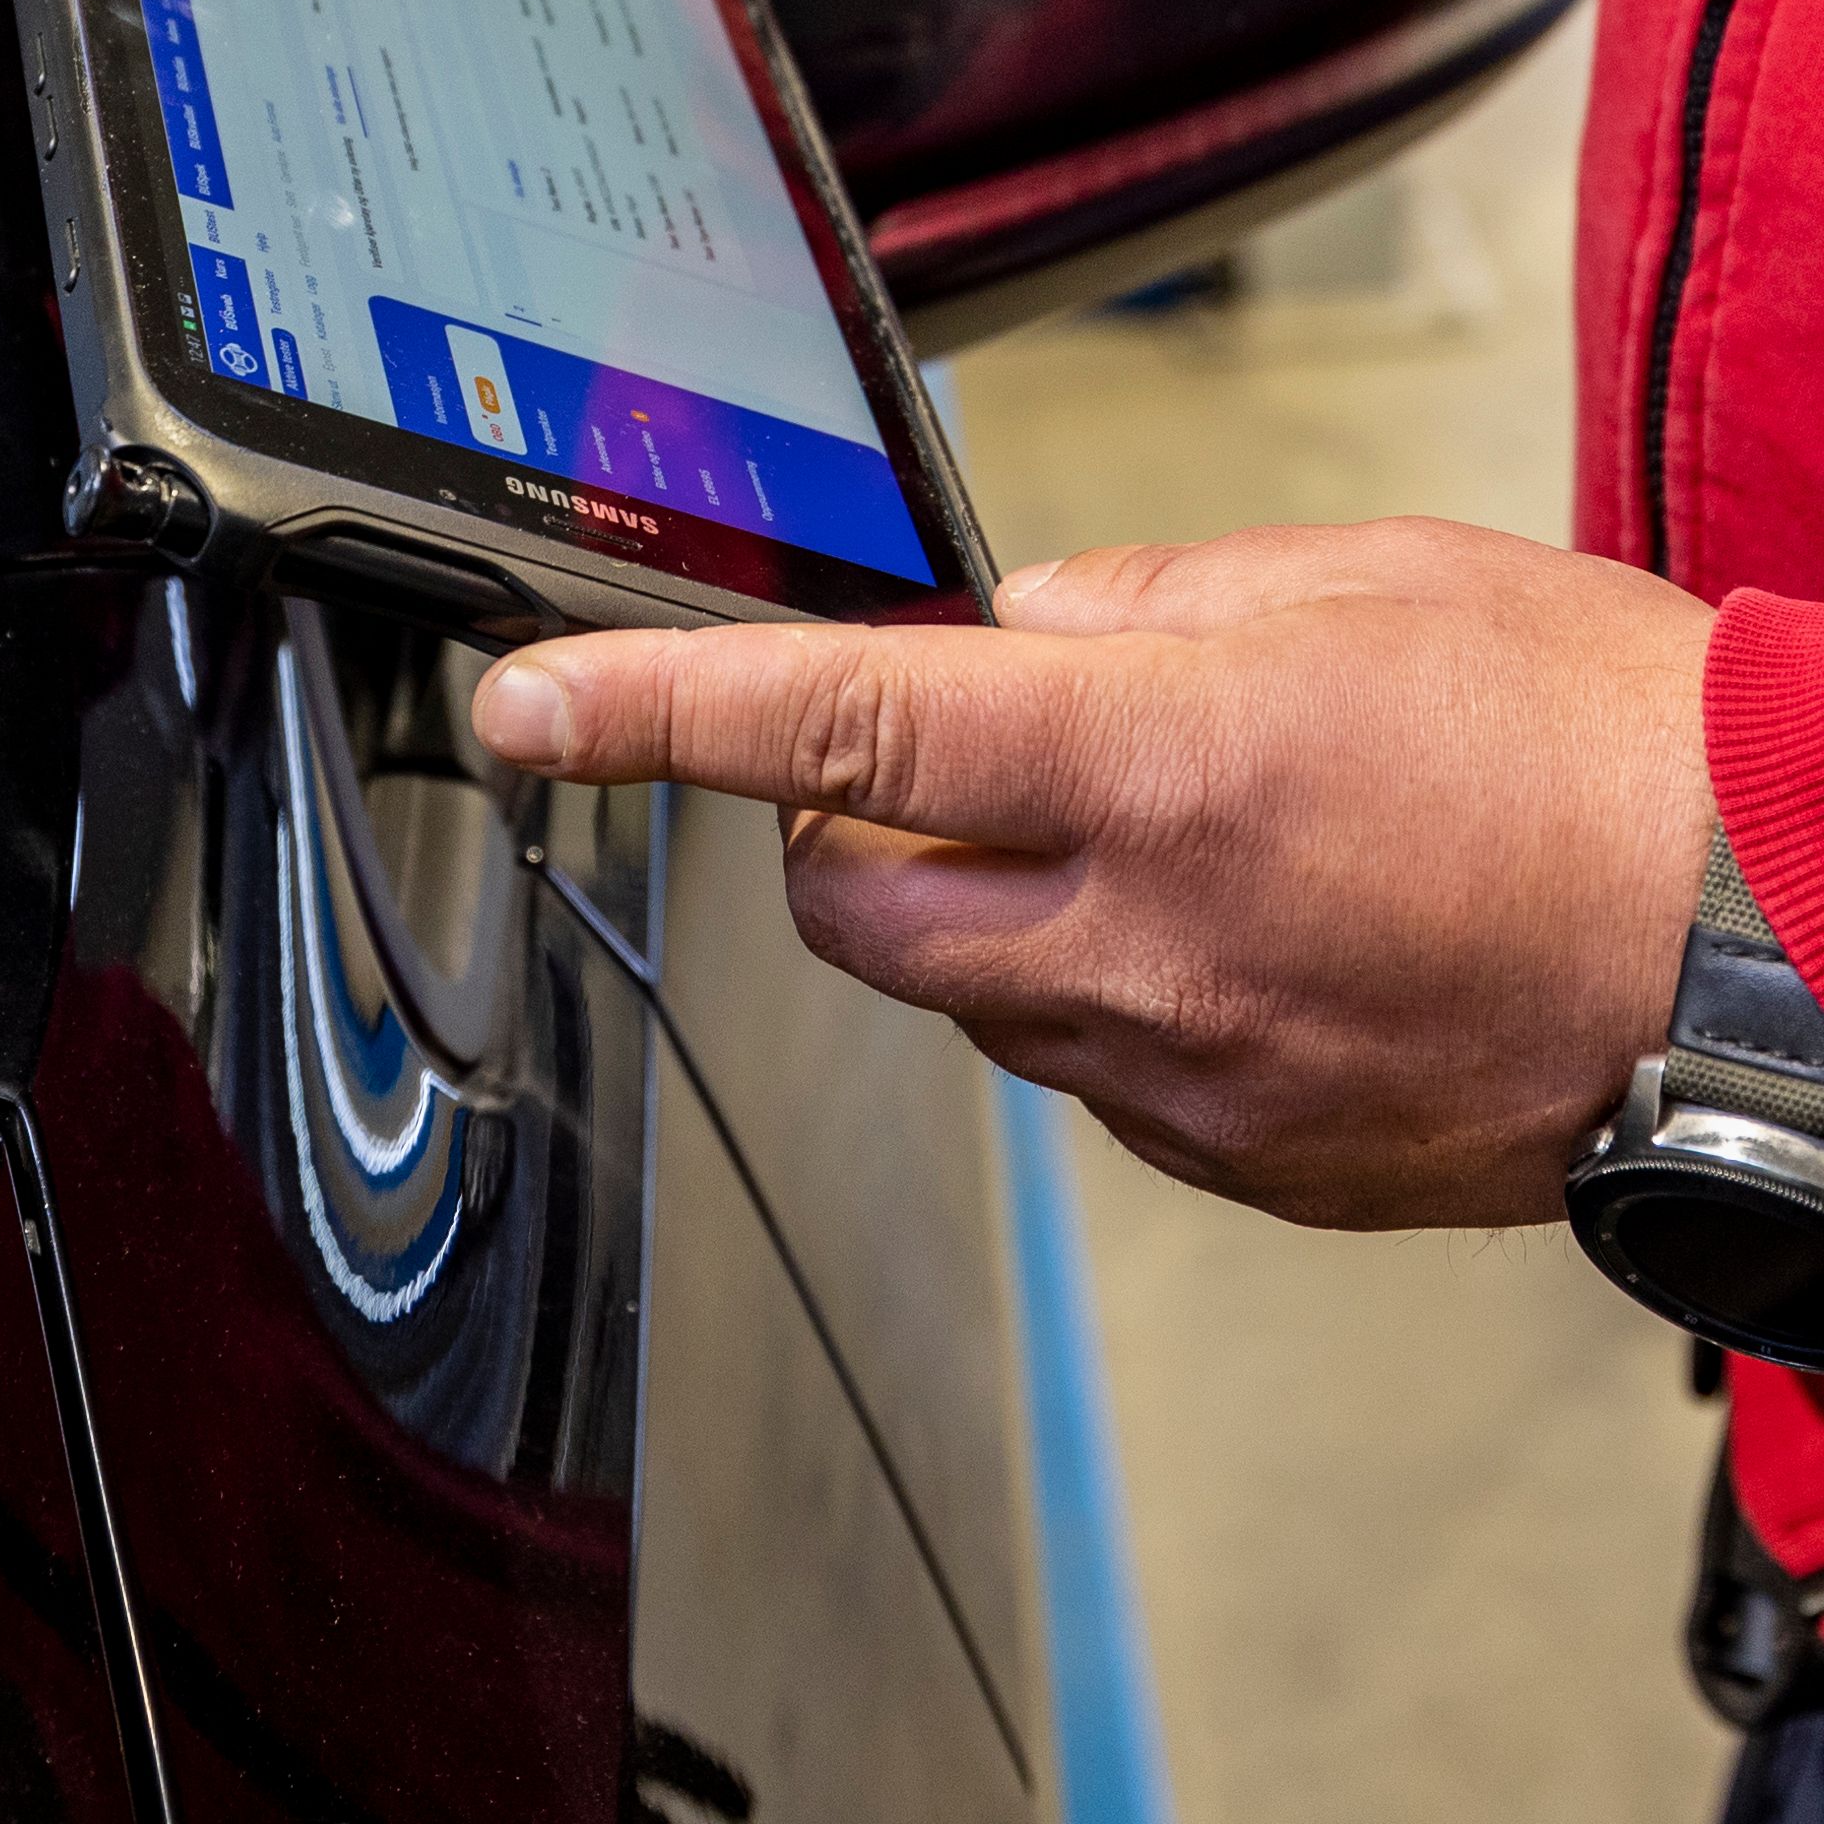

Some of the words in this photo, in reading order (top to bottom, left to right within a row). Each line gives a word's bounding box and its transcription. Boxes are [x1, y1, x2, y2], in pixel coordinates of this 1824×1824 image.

[205, 210, 220, 244] BUStest
[256, 232, 270, 253] Hjelp
[215, 259, 228, 279] Kurs
[265, 269, 282, 314] Testregister
[305, 275, 318, 295] Logg
[311, 302, 327, 340] Kataloger
[185, 334, 204, 362] 12:47
[279, 339, 293, 363] tester
[285, 364, 298, 391] Aktive
[427, 375, 448, 425] Informasjon
[490, 423, 504, 442] OBD
[537, 408, 558, 456] Testpunkter
[642, 430, 655, 452] video
[591, 426, 613, 474] Avlesninger
[649, 453, 660, 465] og
[653, 465, 667, 490] Bilder
[746, 460, 774, 521] Oppsummering
[505, 476, 659, 535] SAMSUNG
